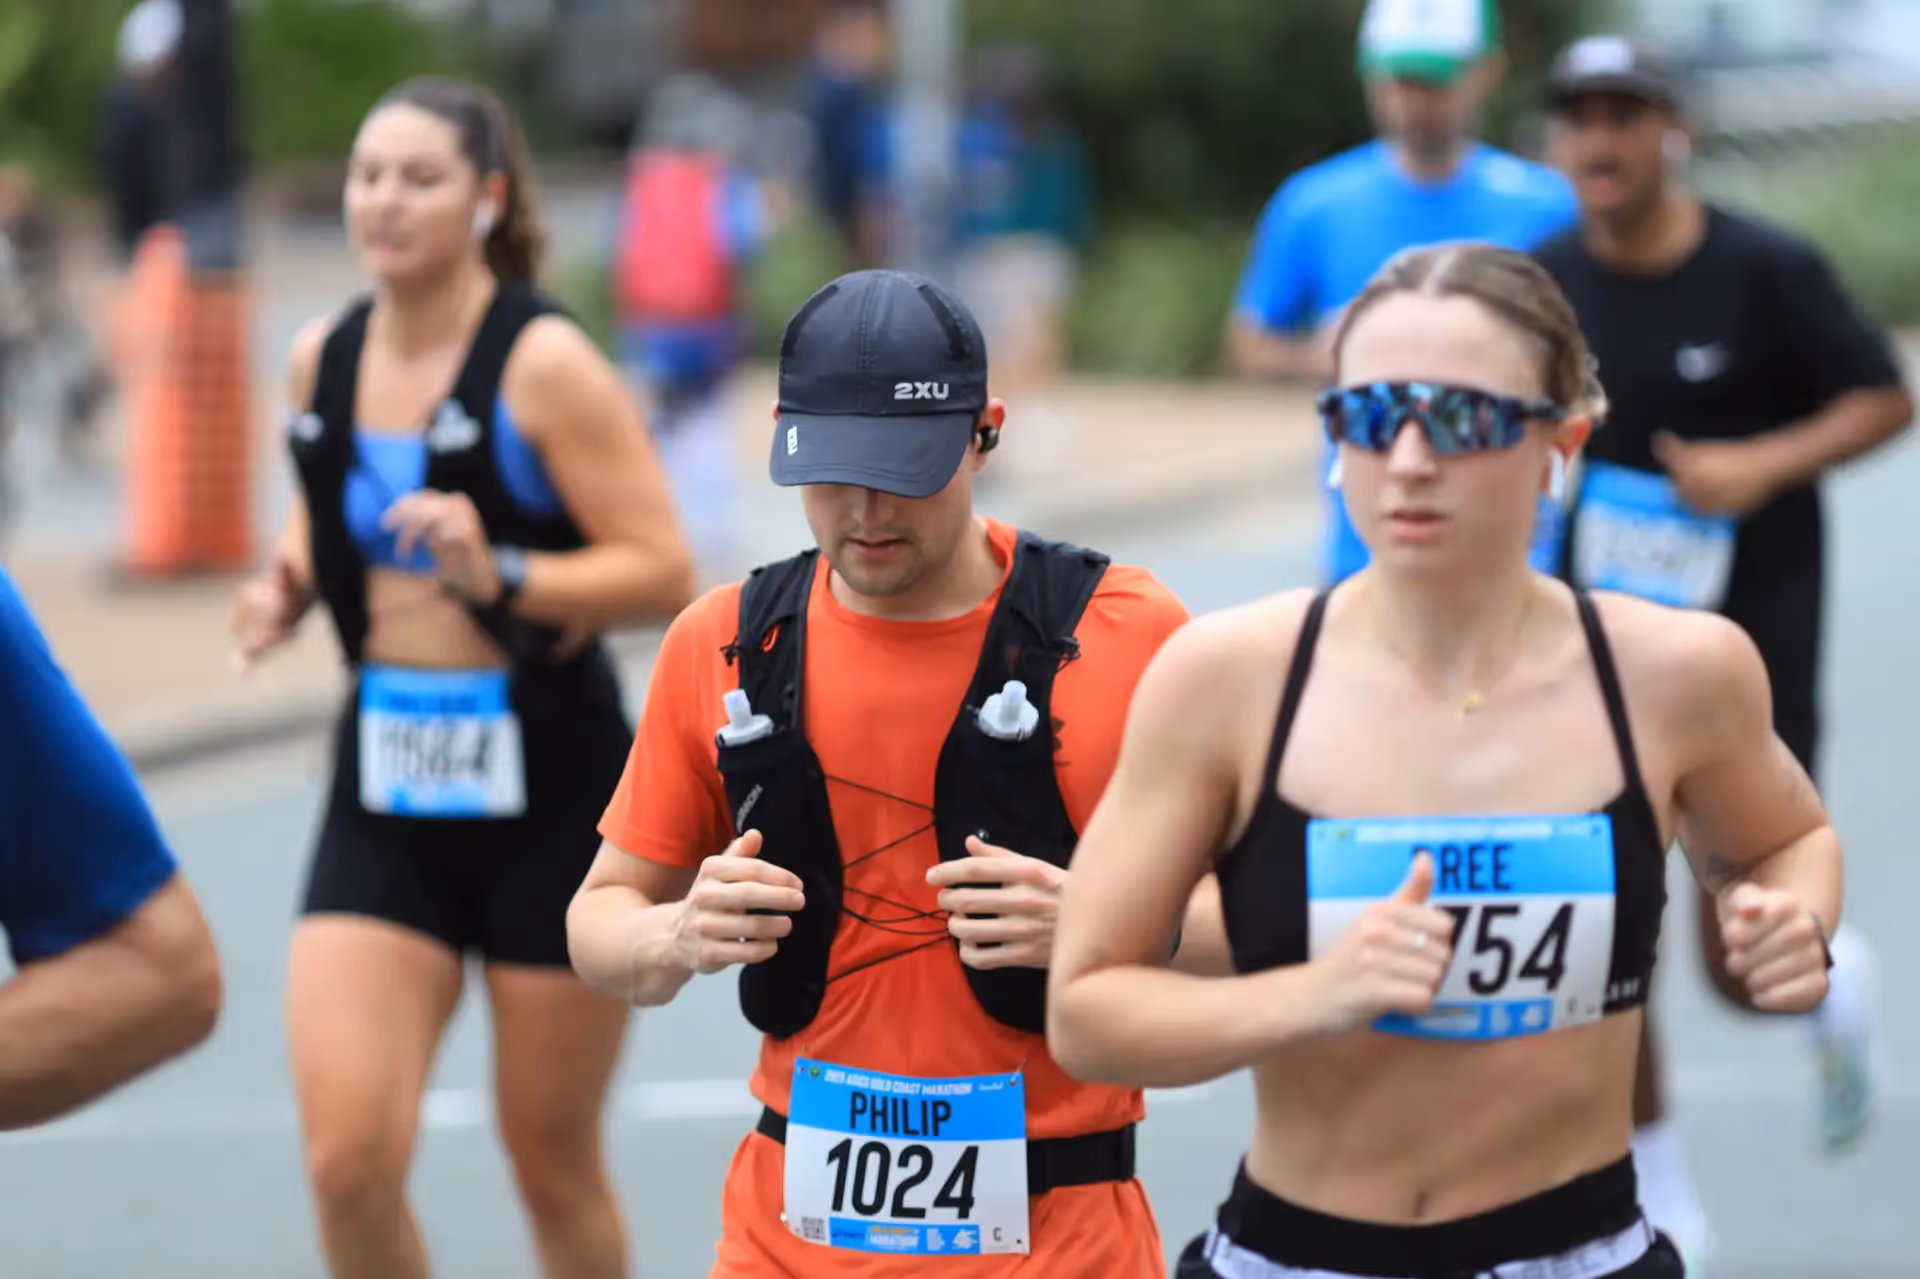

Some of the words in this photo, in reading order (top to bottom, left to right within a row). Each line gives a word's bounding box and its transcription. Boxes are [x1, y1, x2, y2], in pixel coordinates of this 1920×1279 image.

[894, 381, 949, 400] 2XU
[1411, 843, 1513, 892] REE
[1432, 902, 1575, 996] 754
[870, 1074, 893, 1092] GOLD
[893, 1078, 921, 1095] COAST
[922, 1082, 973, 1096] MARATHON
[850, 1091, 952, 1137] PHILIP
[826, 1138, 980, 1220] 1024
